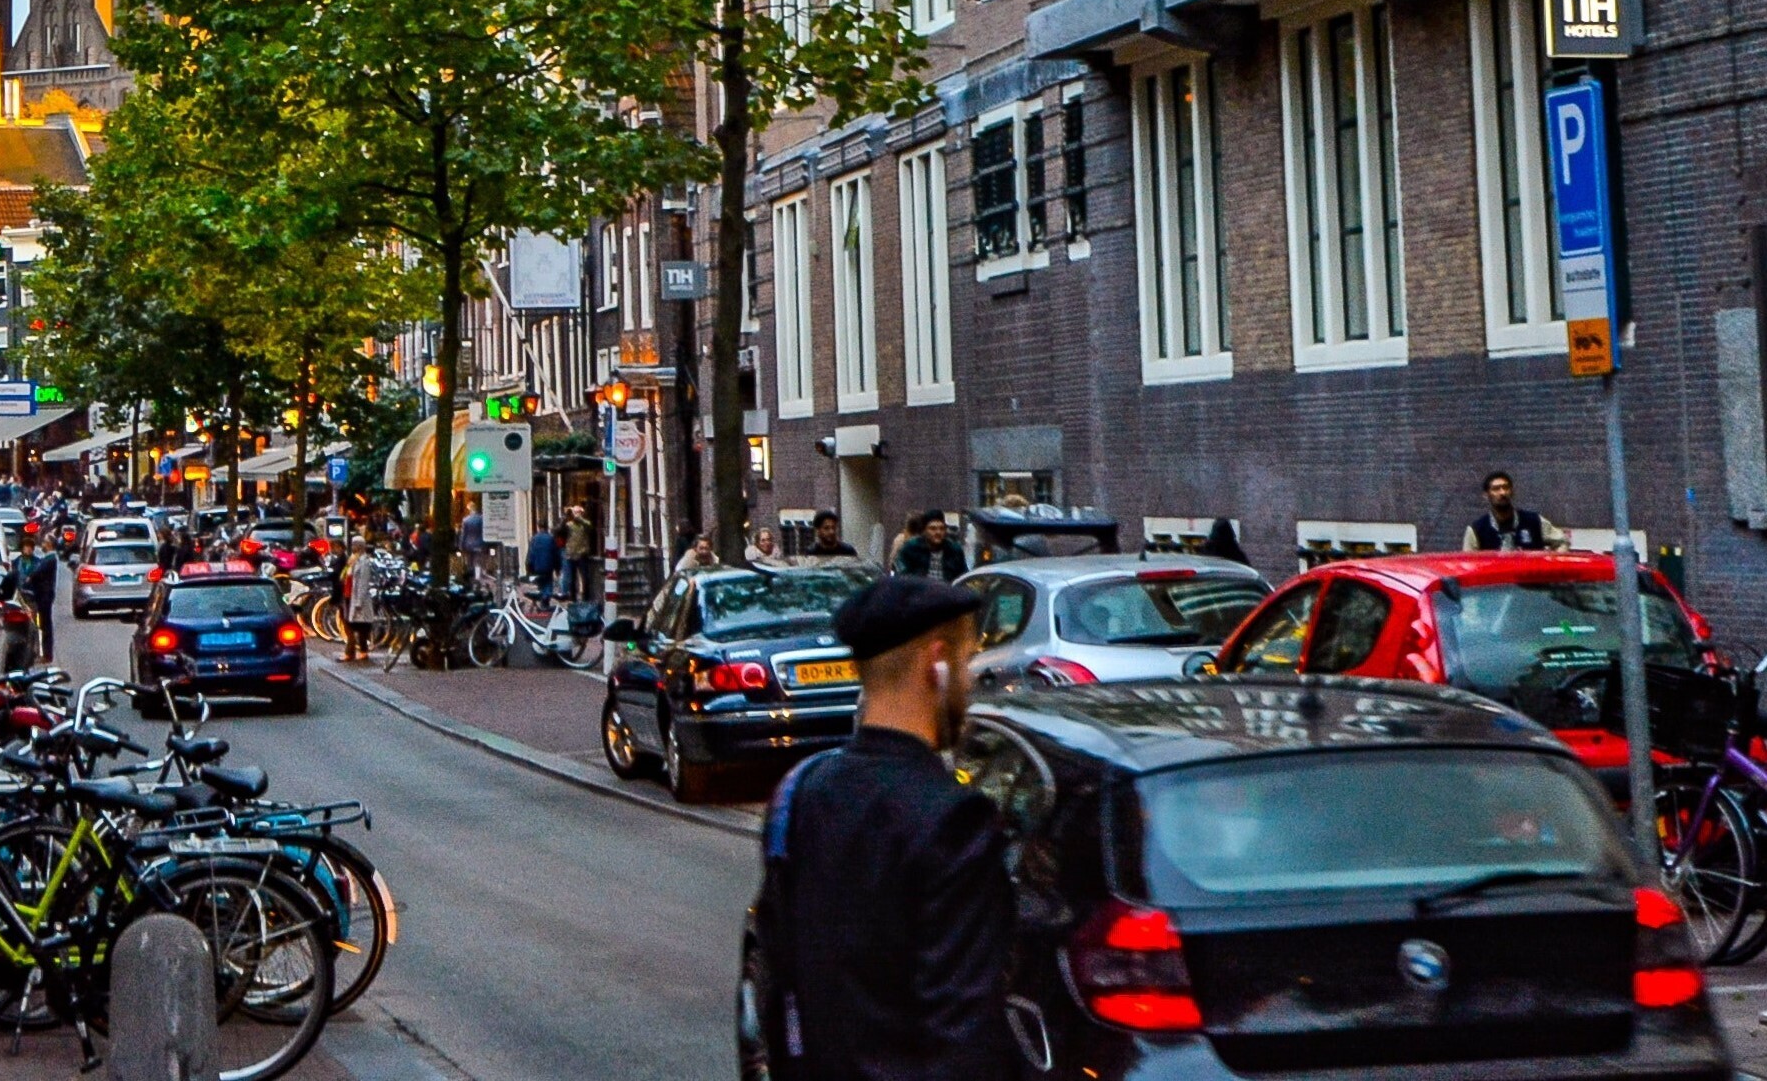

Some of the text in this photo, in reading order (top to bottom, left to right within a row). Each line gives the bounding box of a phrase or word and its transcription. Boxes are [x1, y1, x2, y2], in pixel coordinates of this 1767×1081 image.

[1563, 23, 1619, 38] HOTELS
[1557, 103, 1586, 185] P
[332, 466, 341, 479] P
